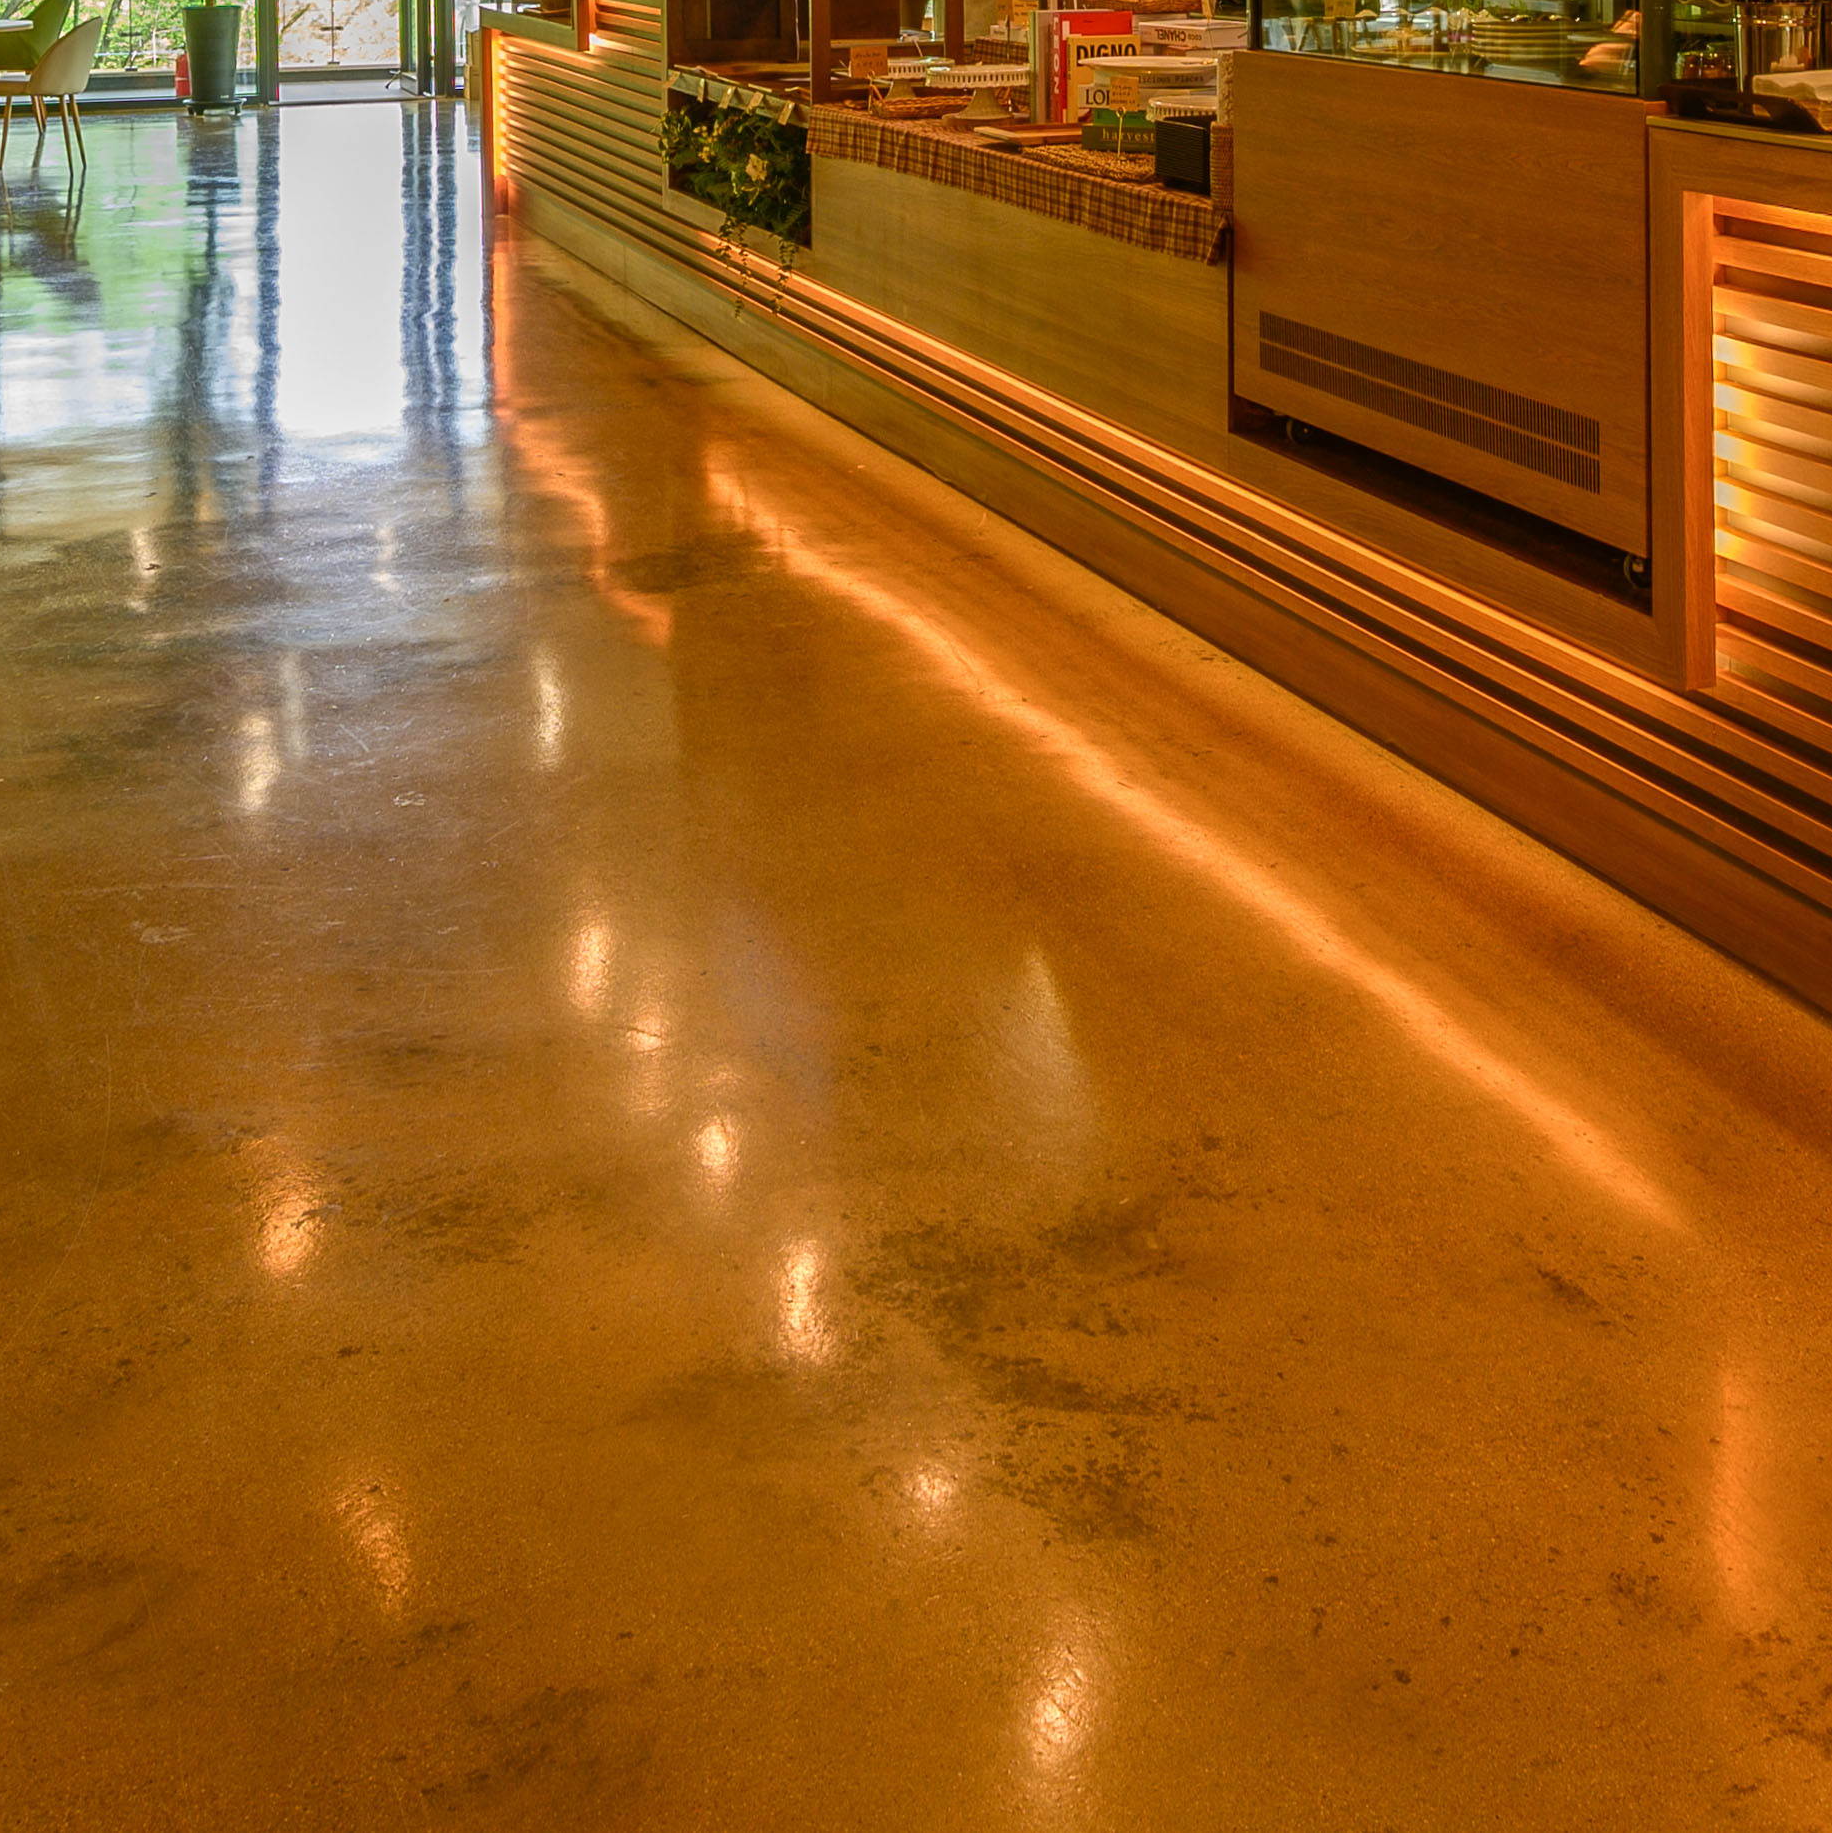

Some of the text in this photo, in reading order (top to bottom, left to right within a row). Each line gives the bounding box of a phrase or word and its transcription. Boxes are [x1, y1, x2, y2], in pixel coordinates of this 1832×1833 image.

[1155, 29, 1186, 43] CHANEL
[1138, 75, 1170, 84] licious
[1102, 127, 1155, 142] harvest
